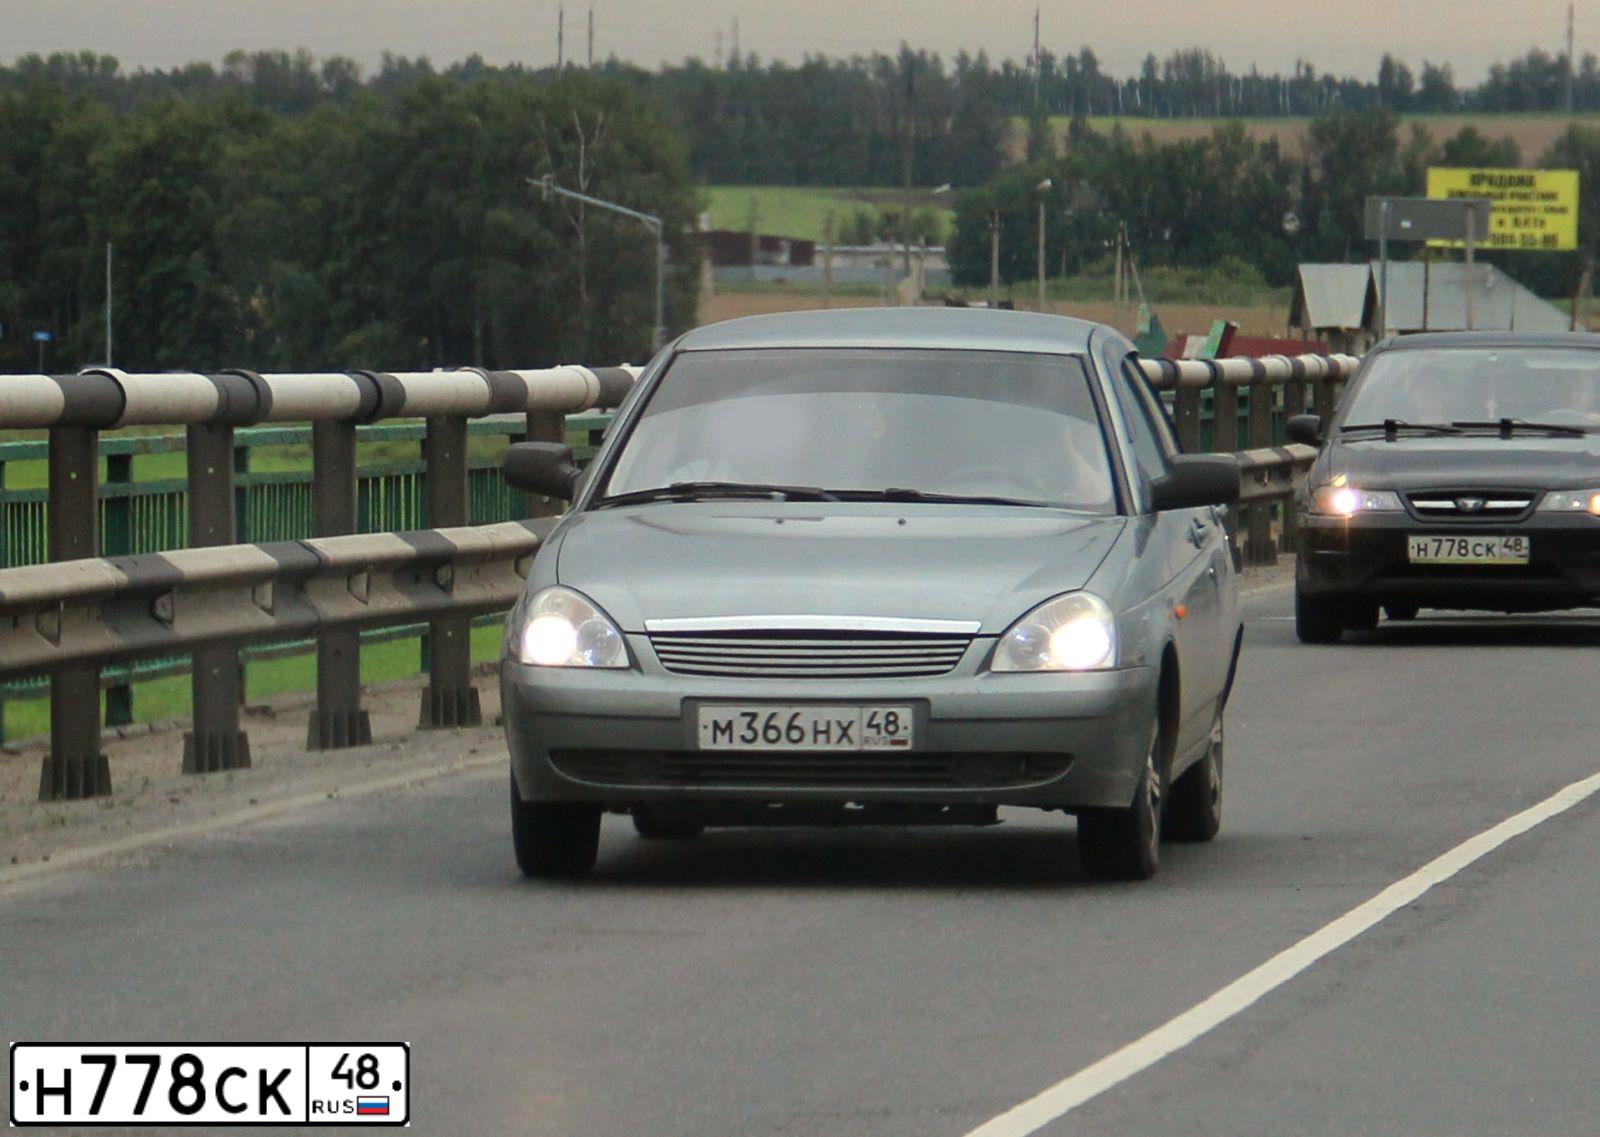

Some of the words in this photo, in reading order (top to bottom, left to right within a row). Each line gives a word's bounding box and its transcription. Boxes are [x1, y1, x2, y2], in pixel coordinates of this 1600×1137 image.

[1503, 537, 1523, 552] 48
[712, 712, 854, 744] М366НХ
[866, 711, 899, 736] 48
[864, 738, 890, 746] RUS
